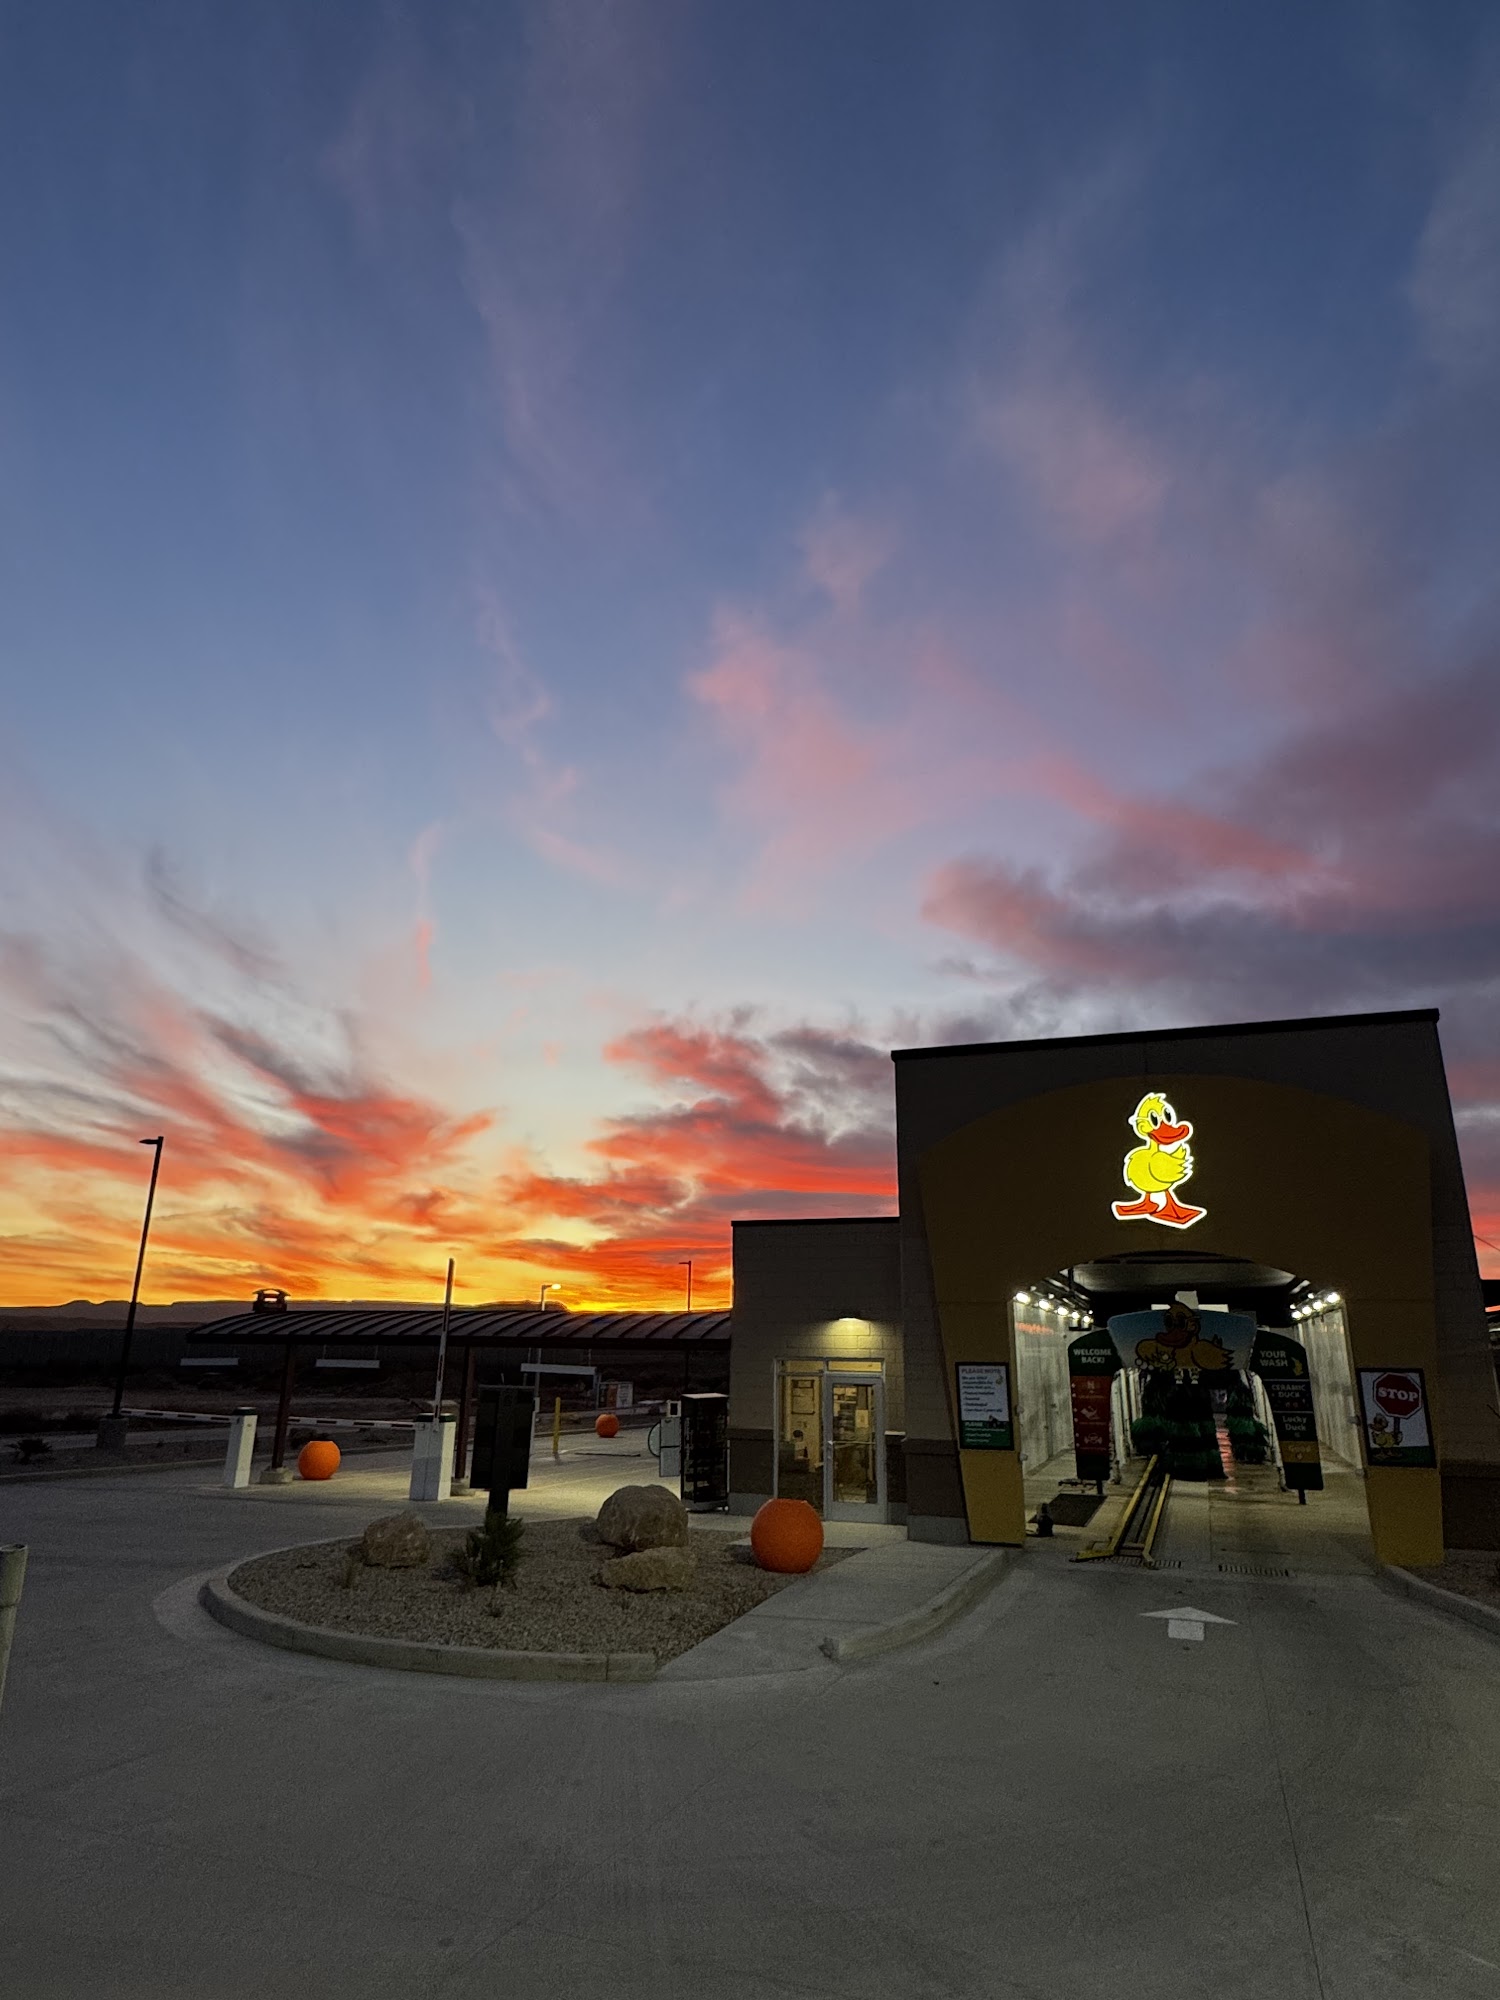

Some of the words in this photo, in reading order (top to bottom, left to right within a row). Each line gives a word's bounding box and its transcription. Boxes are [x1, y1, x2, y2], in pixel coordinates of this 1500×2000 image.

[1073, 1348, 1112, 1356] WELCOME
[1259, 1350, 1286, 1358] YOUR
[1081, 1356, 1105, 1364] BACK!
[1259, 1358, 1288, 1367] WASH
[1378, 1387, 1418, 1402] STOP
[1285, 1423, 1306, 1431] Duck
